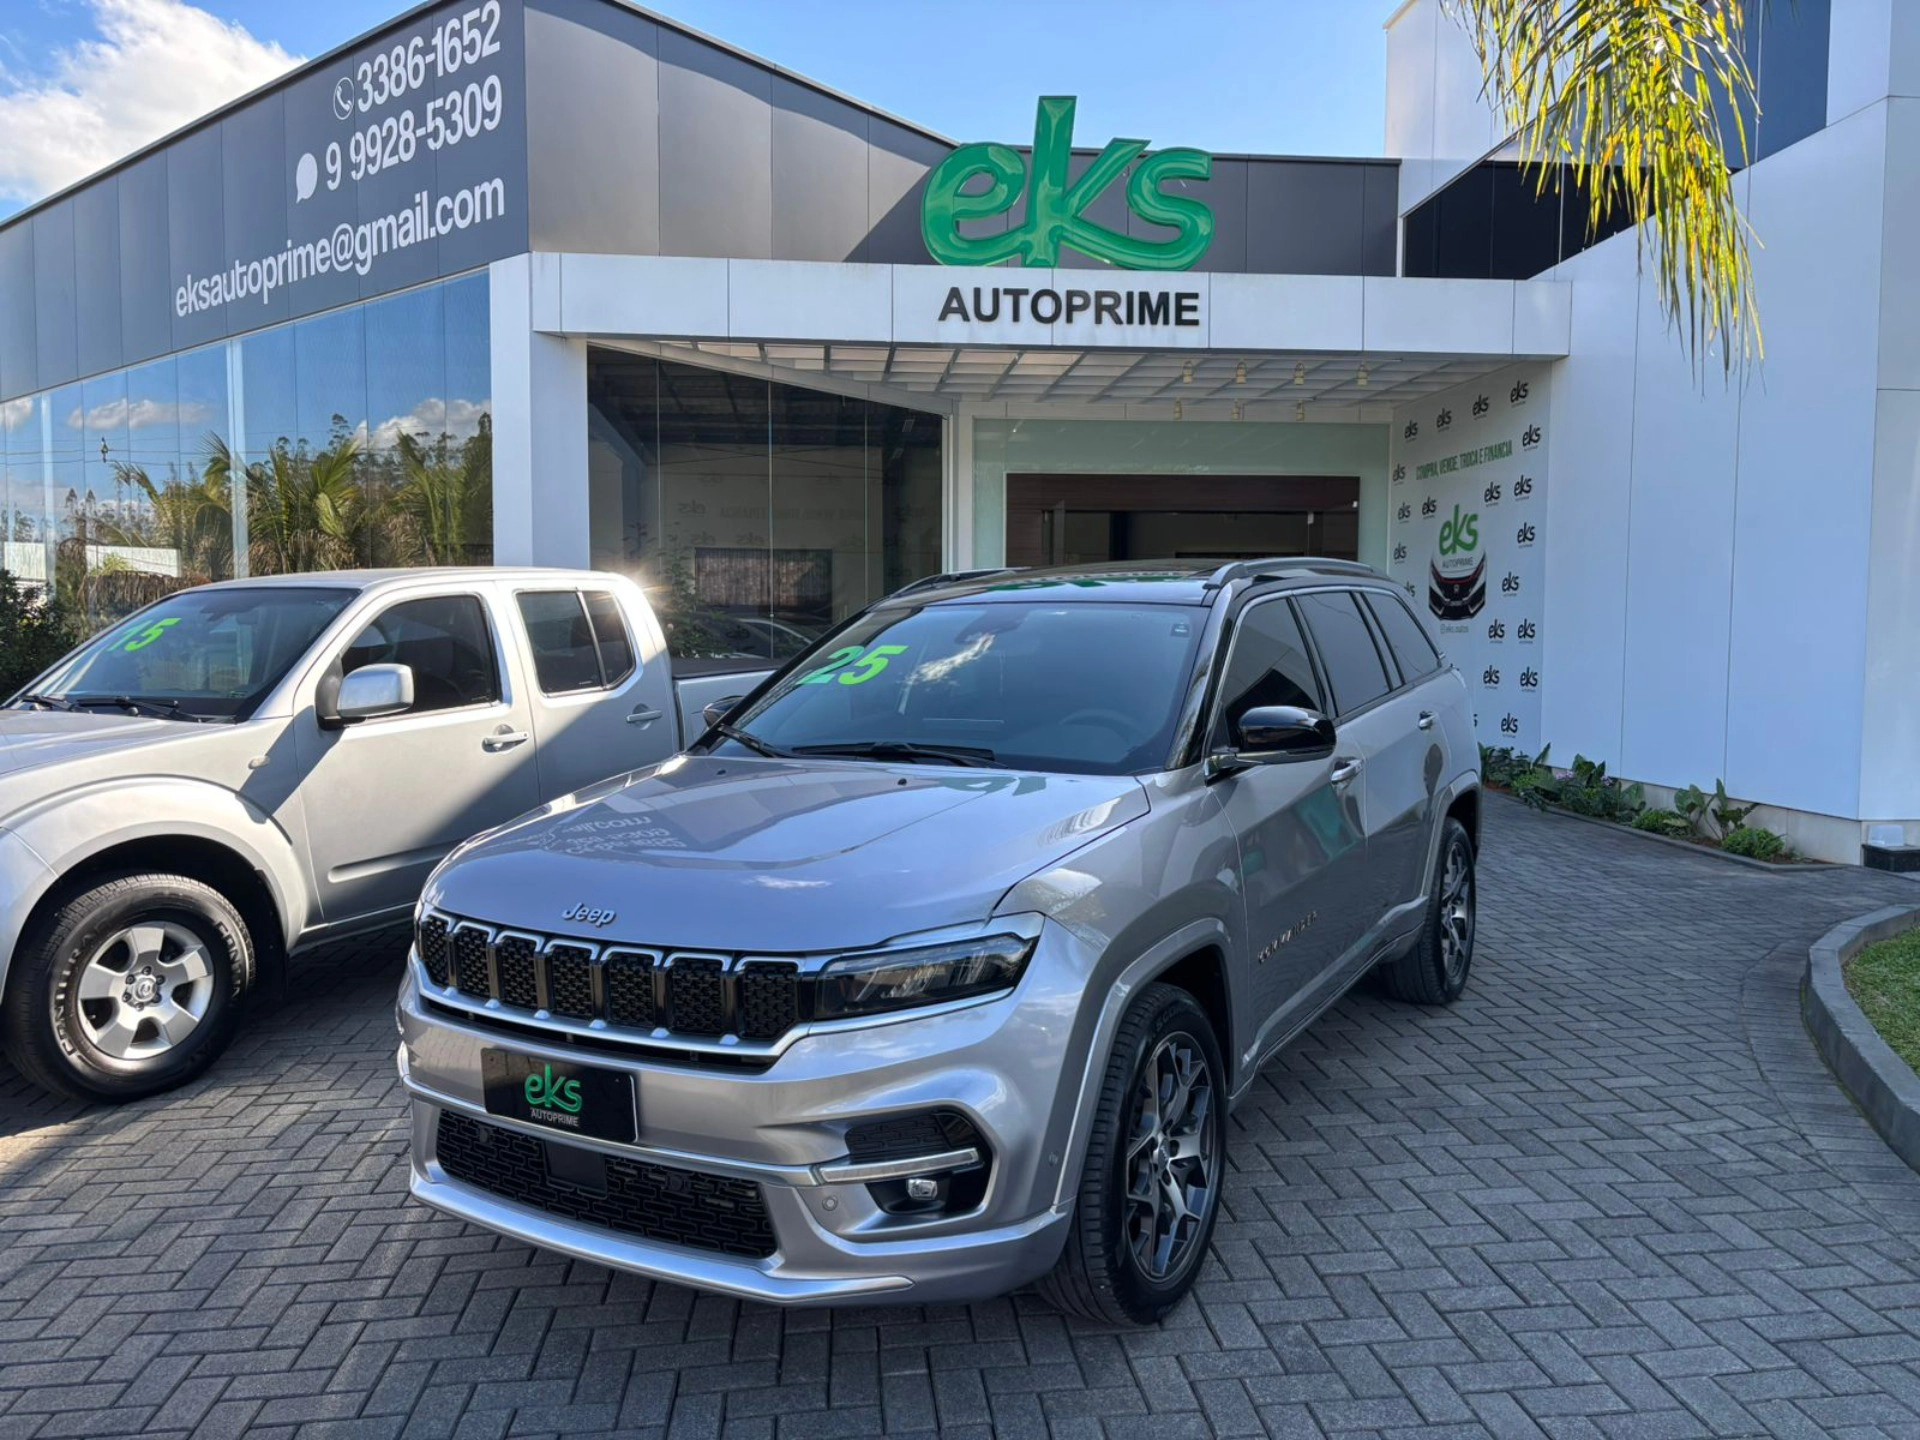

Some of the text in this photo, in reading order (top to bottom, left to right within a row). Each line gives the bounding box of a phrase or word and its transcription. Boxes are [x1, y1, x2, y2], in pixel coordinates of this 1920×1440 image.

[357, 0, 500, 113] 3386-1652
[326, 75, 502, 190] 9 9928-5309
[921, 95, 1215, 271] eks
[175, 177, 505, 318] eksautoprime@gmail.com
[938, 286, 1200, 326] AUTOPRIME
[1510, 380, 1528, 403] eks
[1472, 394, 1489, 416] eks
[1436, 407, 1452, 428] eks
[1522, 423, 1541, 447] eks
[1484, 481, 1501, 503] eks
[1513, 474, 1532, 497] eks
[1421, 496, 1437, 516] eks
[1439, 504, 1478, 556] eks
[1517, 522, 1535, 544] eks
[1502, 571, 1519, 592] eks
[1488, 618, 1505, 639] eks
[1517, 618, 1536, 639] eks
[795, 645, 909, 686] 25
[1483, 665, 1500, 685] eks
[1520, 666, 1538, 687] eks
[1501, 712, 1518, 733] eks
[561, 902, 616, 927] Jeep
[525, 1063, 583, 1112] eks
[530, 1107, 580, 1127] AUTOPRIME
